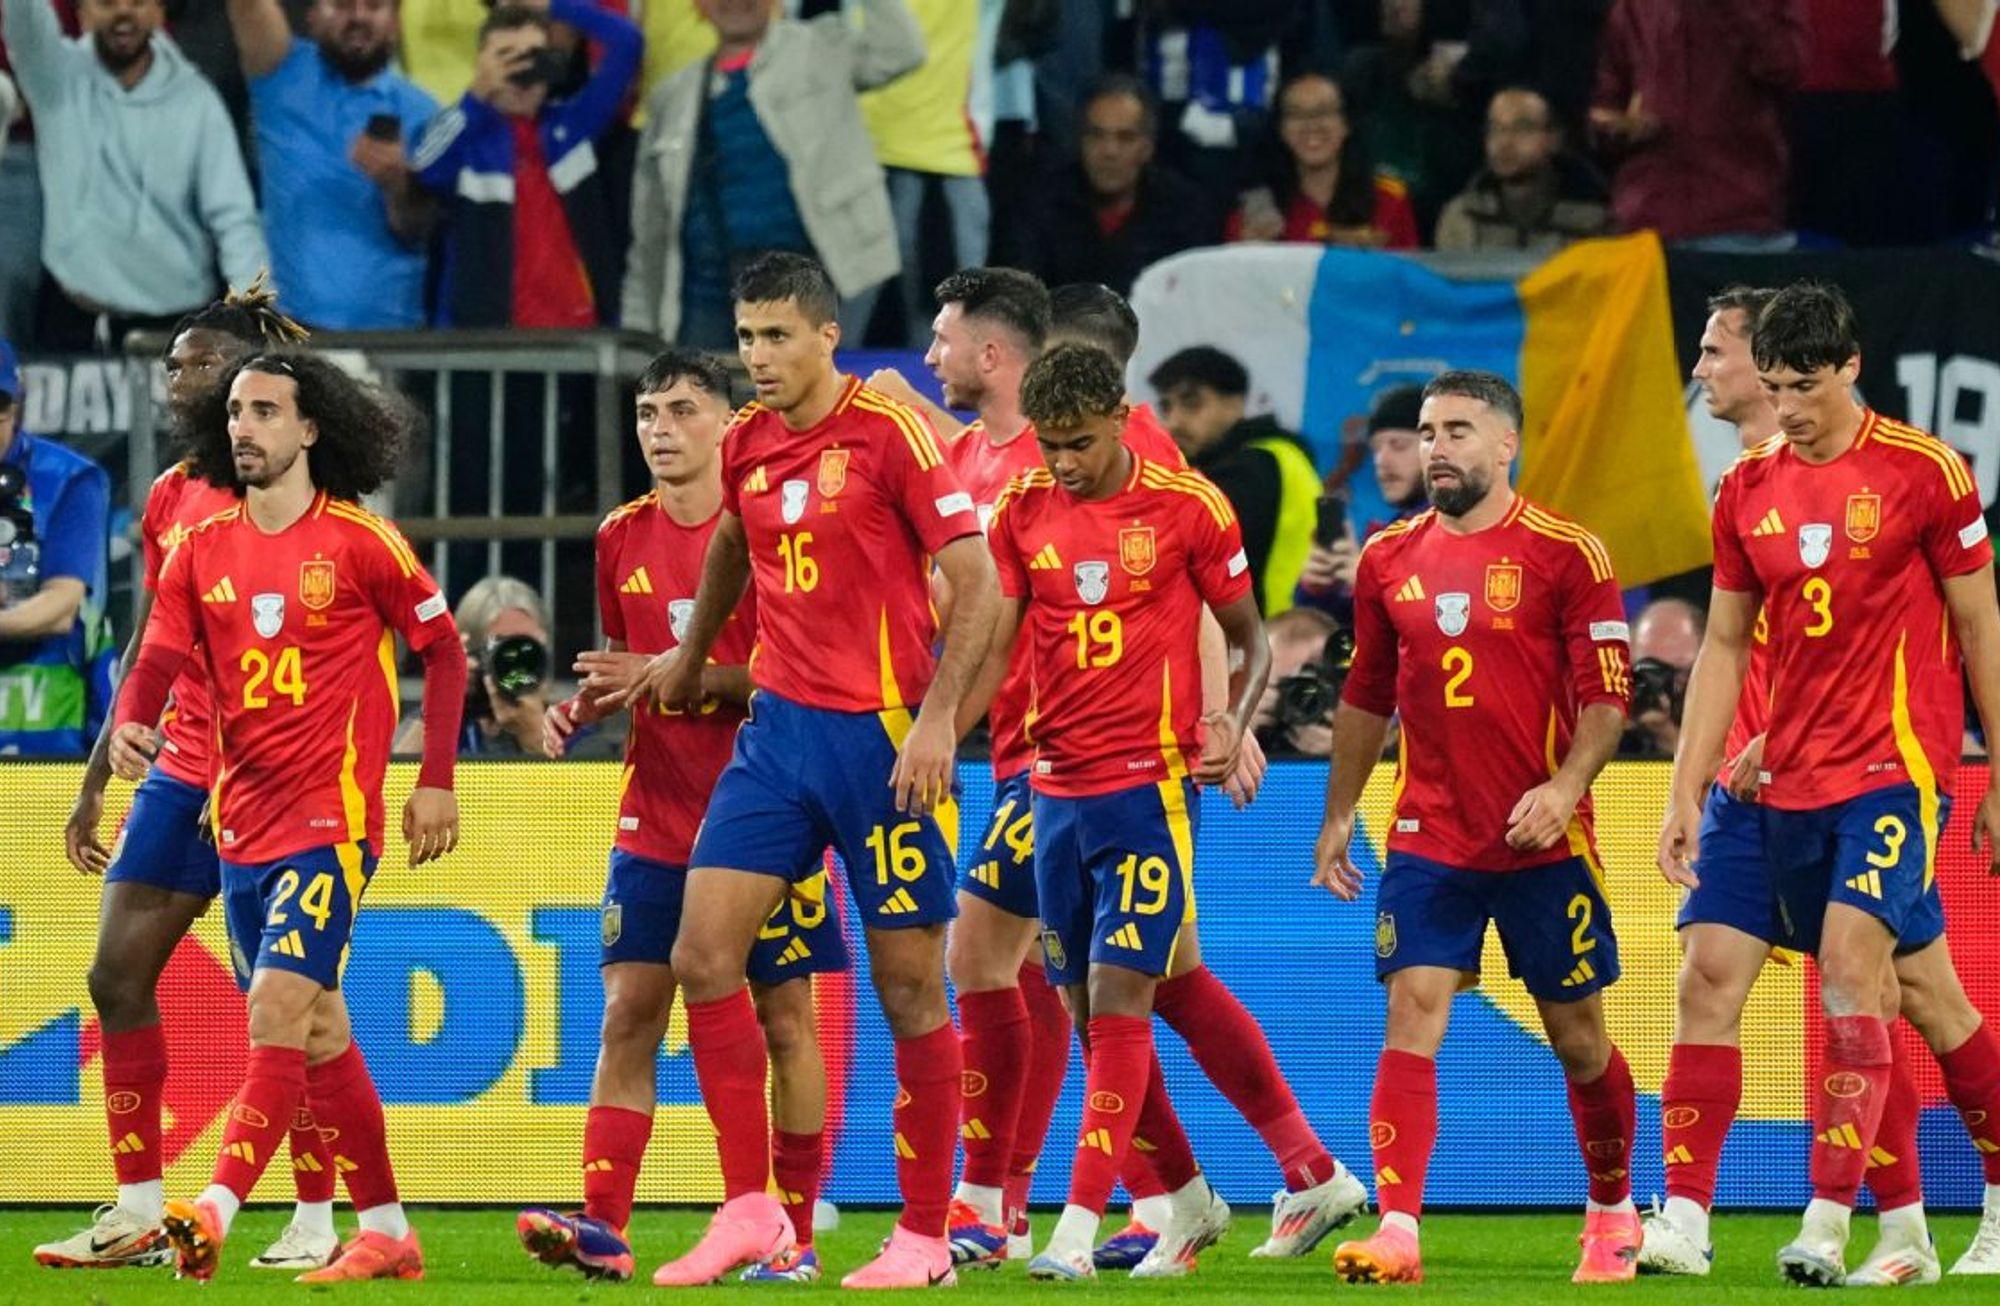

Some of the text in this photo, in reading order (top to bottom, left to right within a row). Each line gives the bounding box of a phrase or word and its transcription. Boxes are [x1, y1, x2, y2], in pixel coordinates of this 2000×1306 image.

[777, 531, 819, 594] 16
[1802, 577, 1833, 638] 3
[1067, 610, 1123, 669] 19
[240, 647, 307, 709] 24
[1442, 646, 1474, 708] 2
[866, 821, 926, 885] 16
[983, 799, 1034, 865] 14
[1866, 815, 1906, 868] 3
[269, 869, 335, 931] 24
[1116, 854, 1170, 915] 19
[1568, 894, 1597, 955] 2
